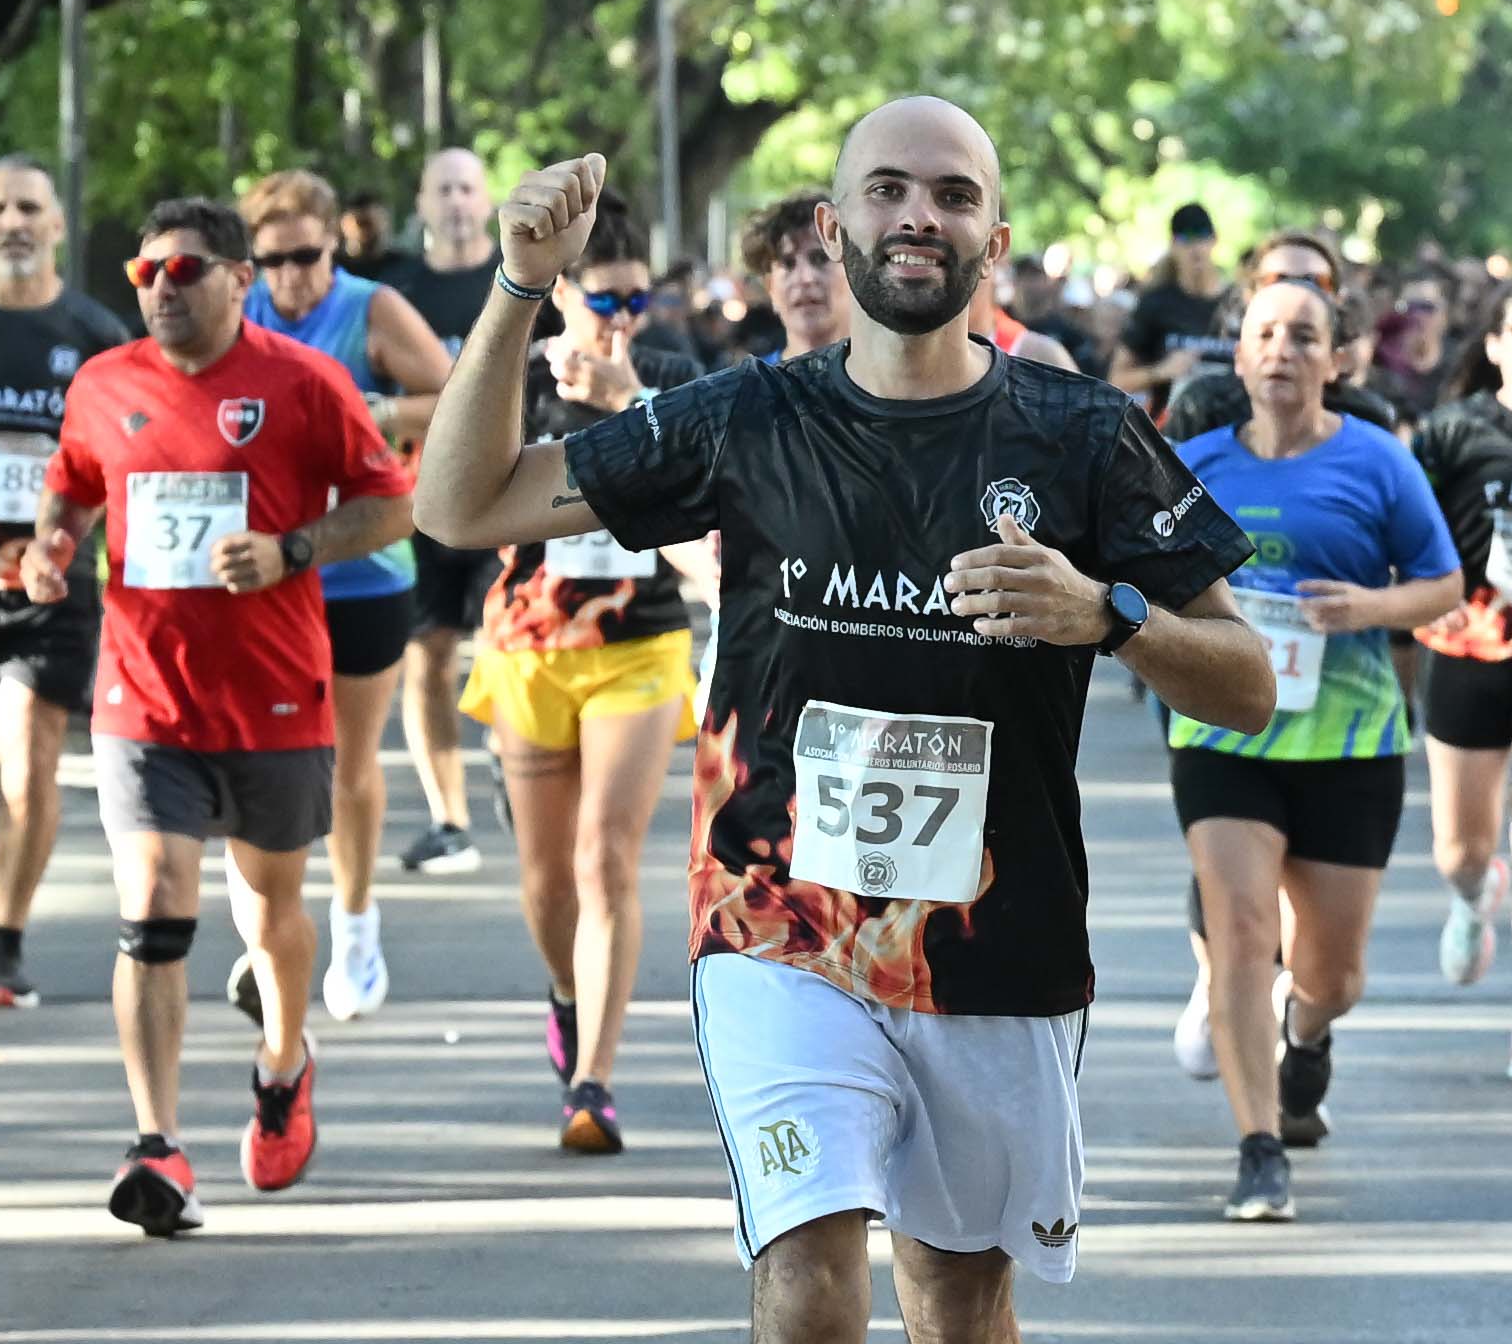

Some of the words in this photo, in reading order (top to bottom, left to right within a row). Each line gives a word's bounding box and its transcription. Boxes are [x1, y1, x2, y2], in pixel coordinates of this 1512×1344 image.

[1172, 484, 1204, 522] Banco
[155, 514, 212, 552] 37
[830, 620, 905, 639] BOMBEROS
[906, 626, 994, 647] VOLUNTARIOS
[850, 727, 963, 757] MARATÓN
[816, 773, 961, 847] 537
